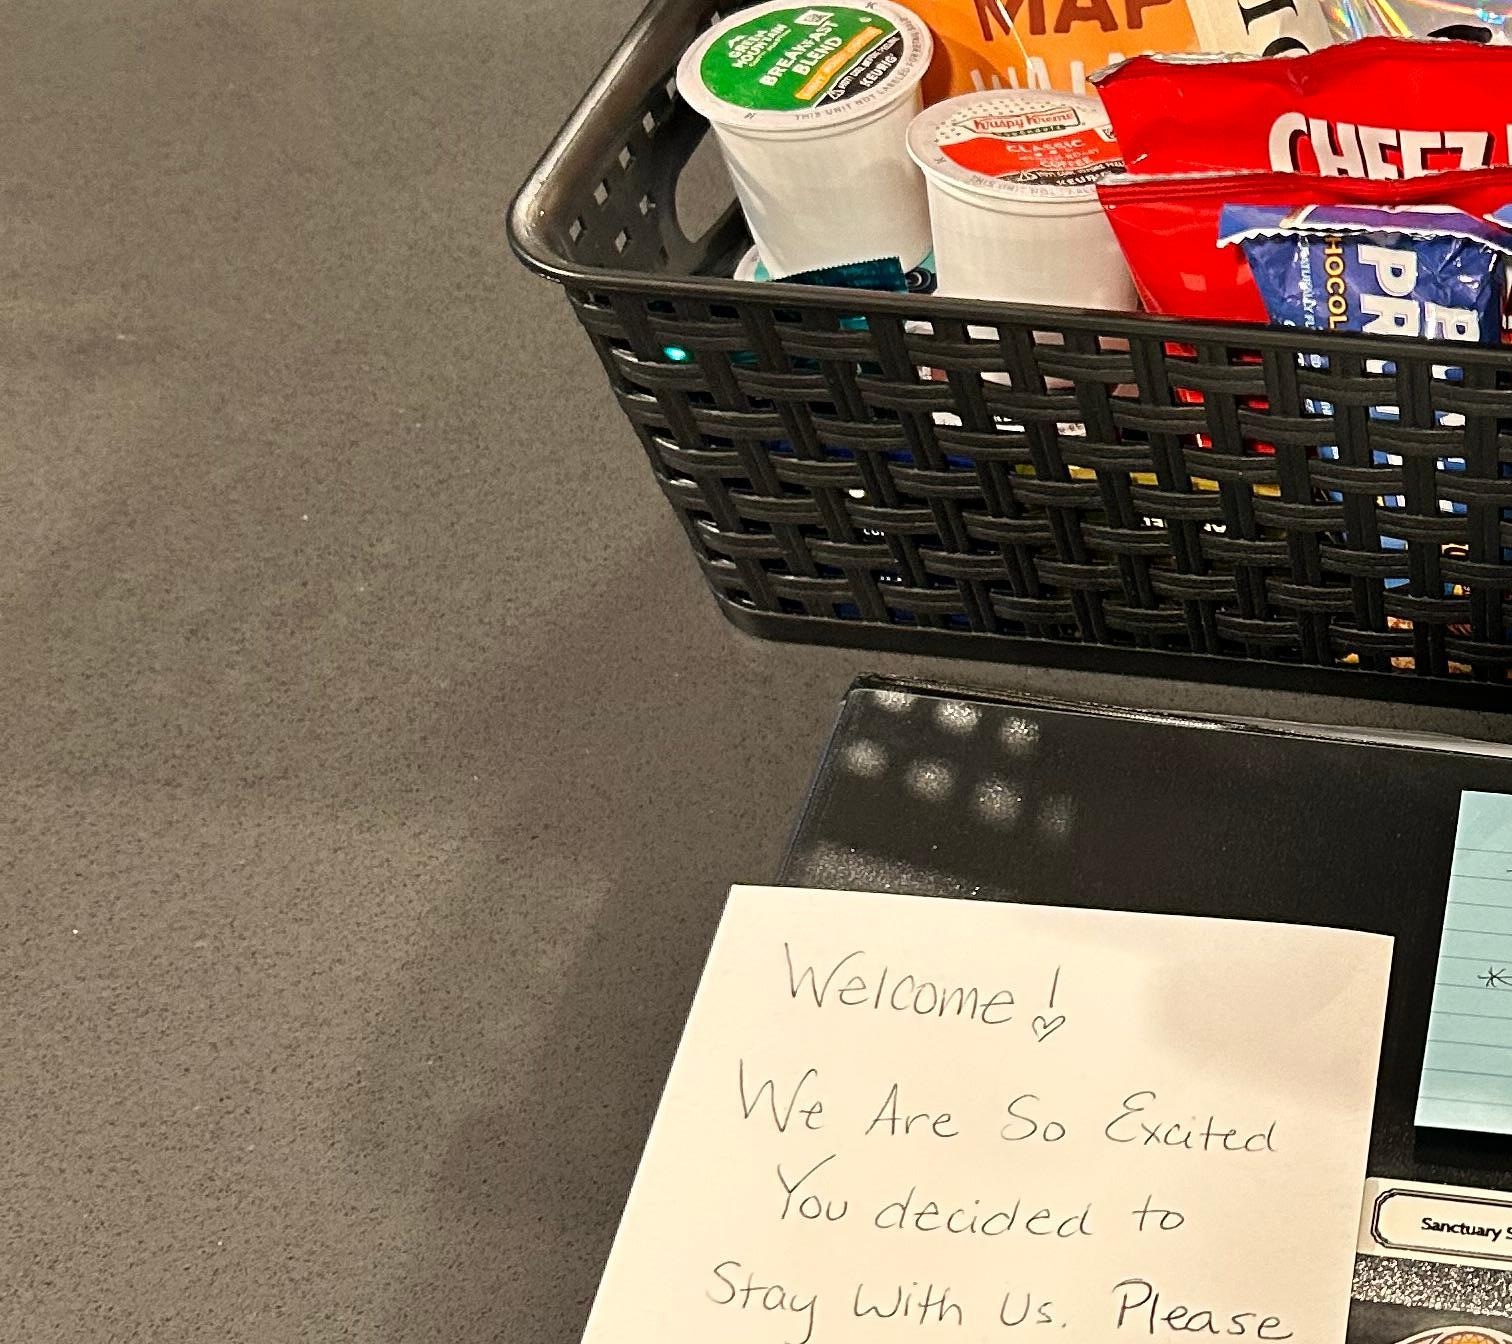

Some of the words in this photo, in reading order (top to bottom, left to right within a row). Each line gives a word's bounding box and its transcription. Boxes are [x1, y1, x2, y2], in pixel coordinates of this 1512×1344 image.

[759, 18, 839, 87] BREAKFAST
[792, 36, 843, 76] BLEND
[738, 1057, 826, 1134] We
[864, 1083, 960, 1140] Are
[999, 1094, 1069, 1143] So
[1103, 1090, 1277, 1154] Excited
[776, 1153, 849, 1222] You
[873, 1187, 1094, 1238] decided
[1132, 1194, 1186, 1233] to
[1421, 1217, 1502, 1243] Sanctuary
[1113, 1278, 1295, 1341] Please
